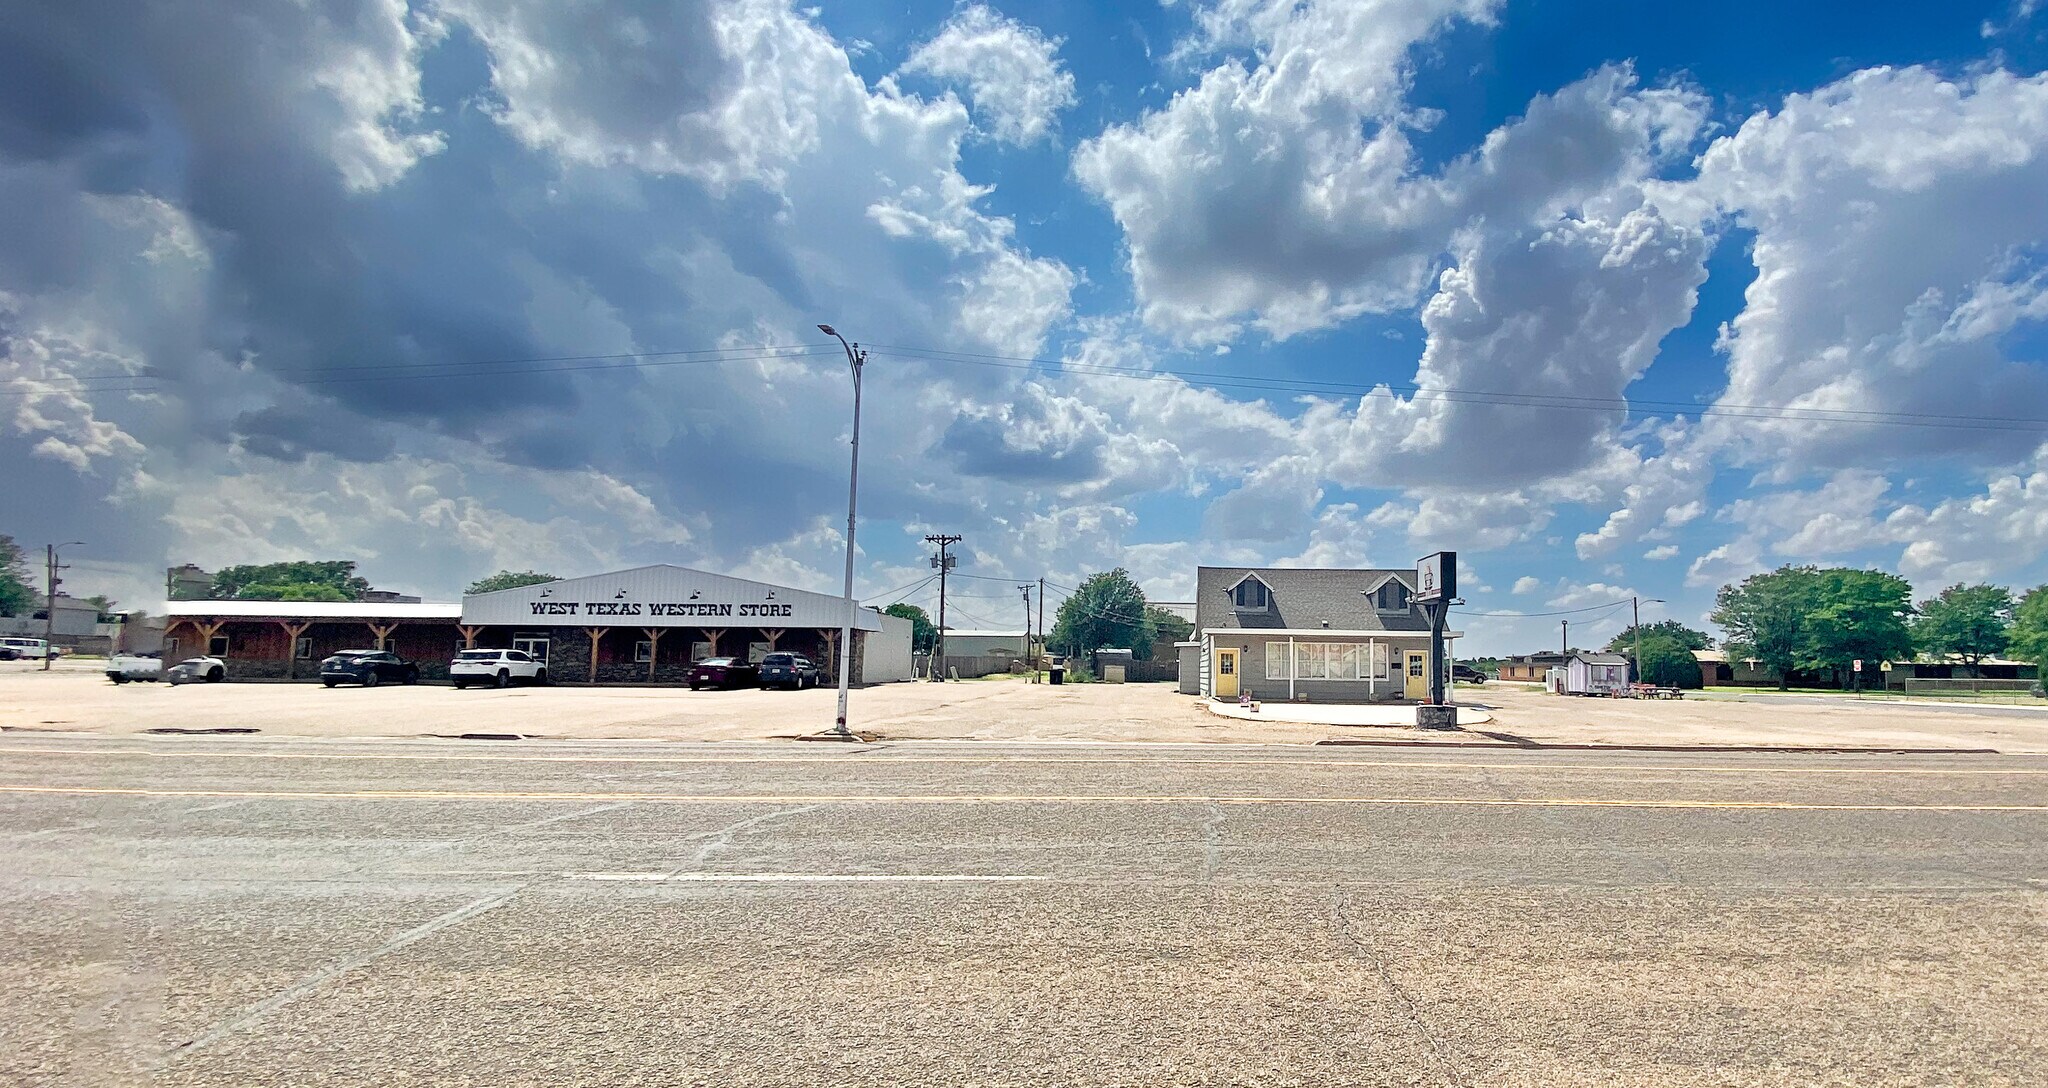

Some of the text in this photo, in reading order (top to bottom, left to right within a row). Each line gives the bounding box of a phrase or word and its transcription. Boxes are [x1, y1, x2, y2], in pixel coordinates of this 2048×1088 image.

[530, 602, 792, 617] WEST TEXAS WESTERN STORE
